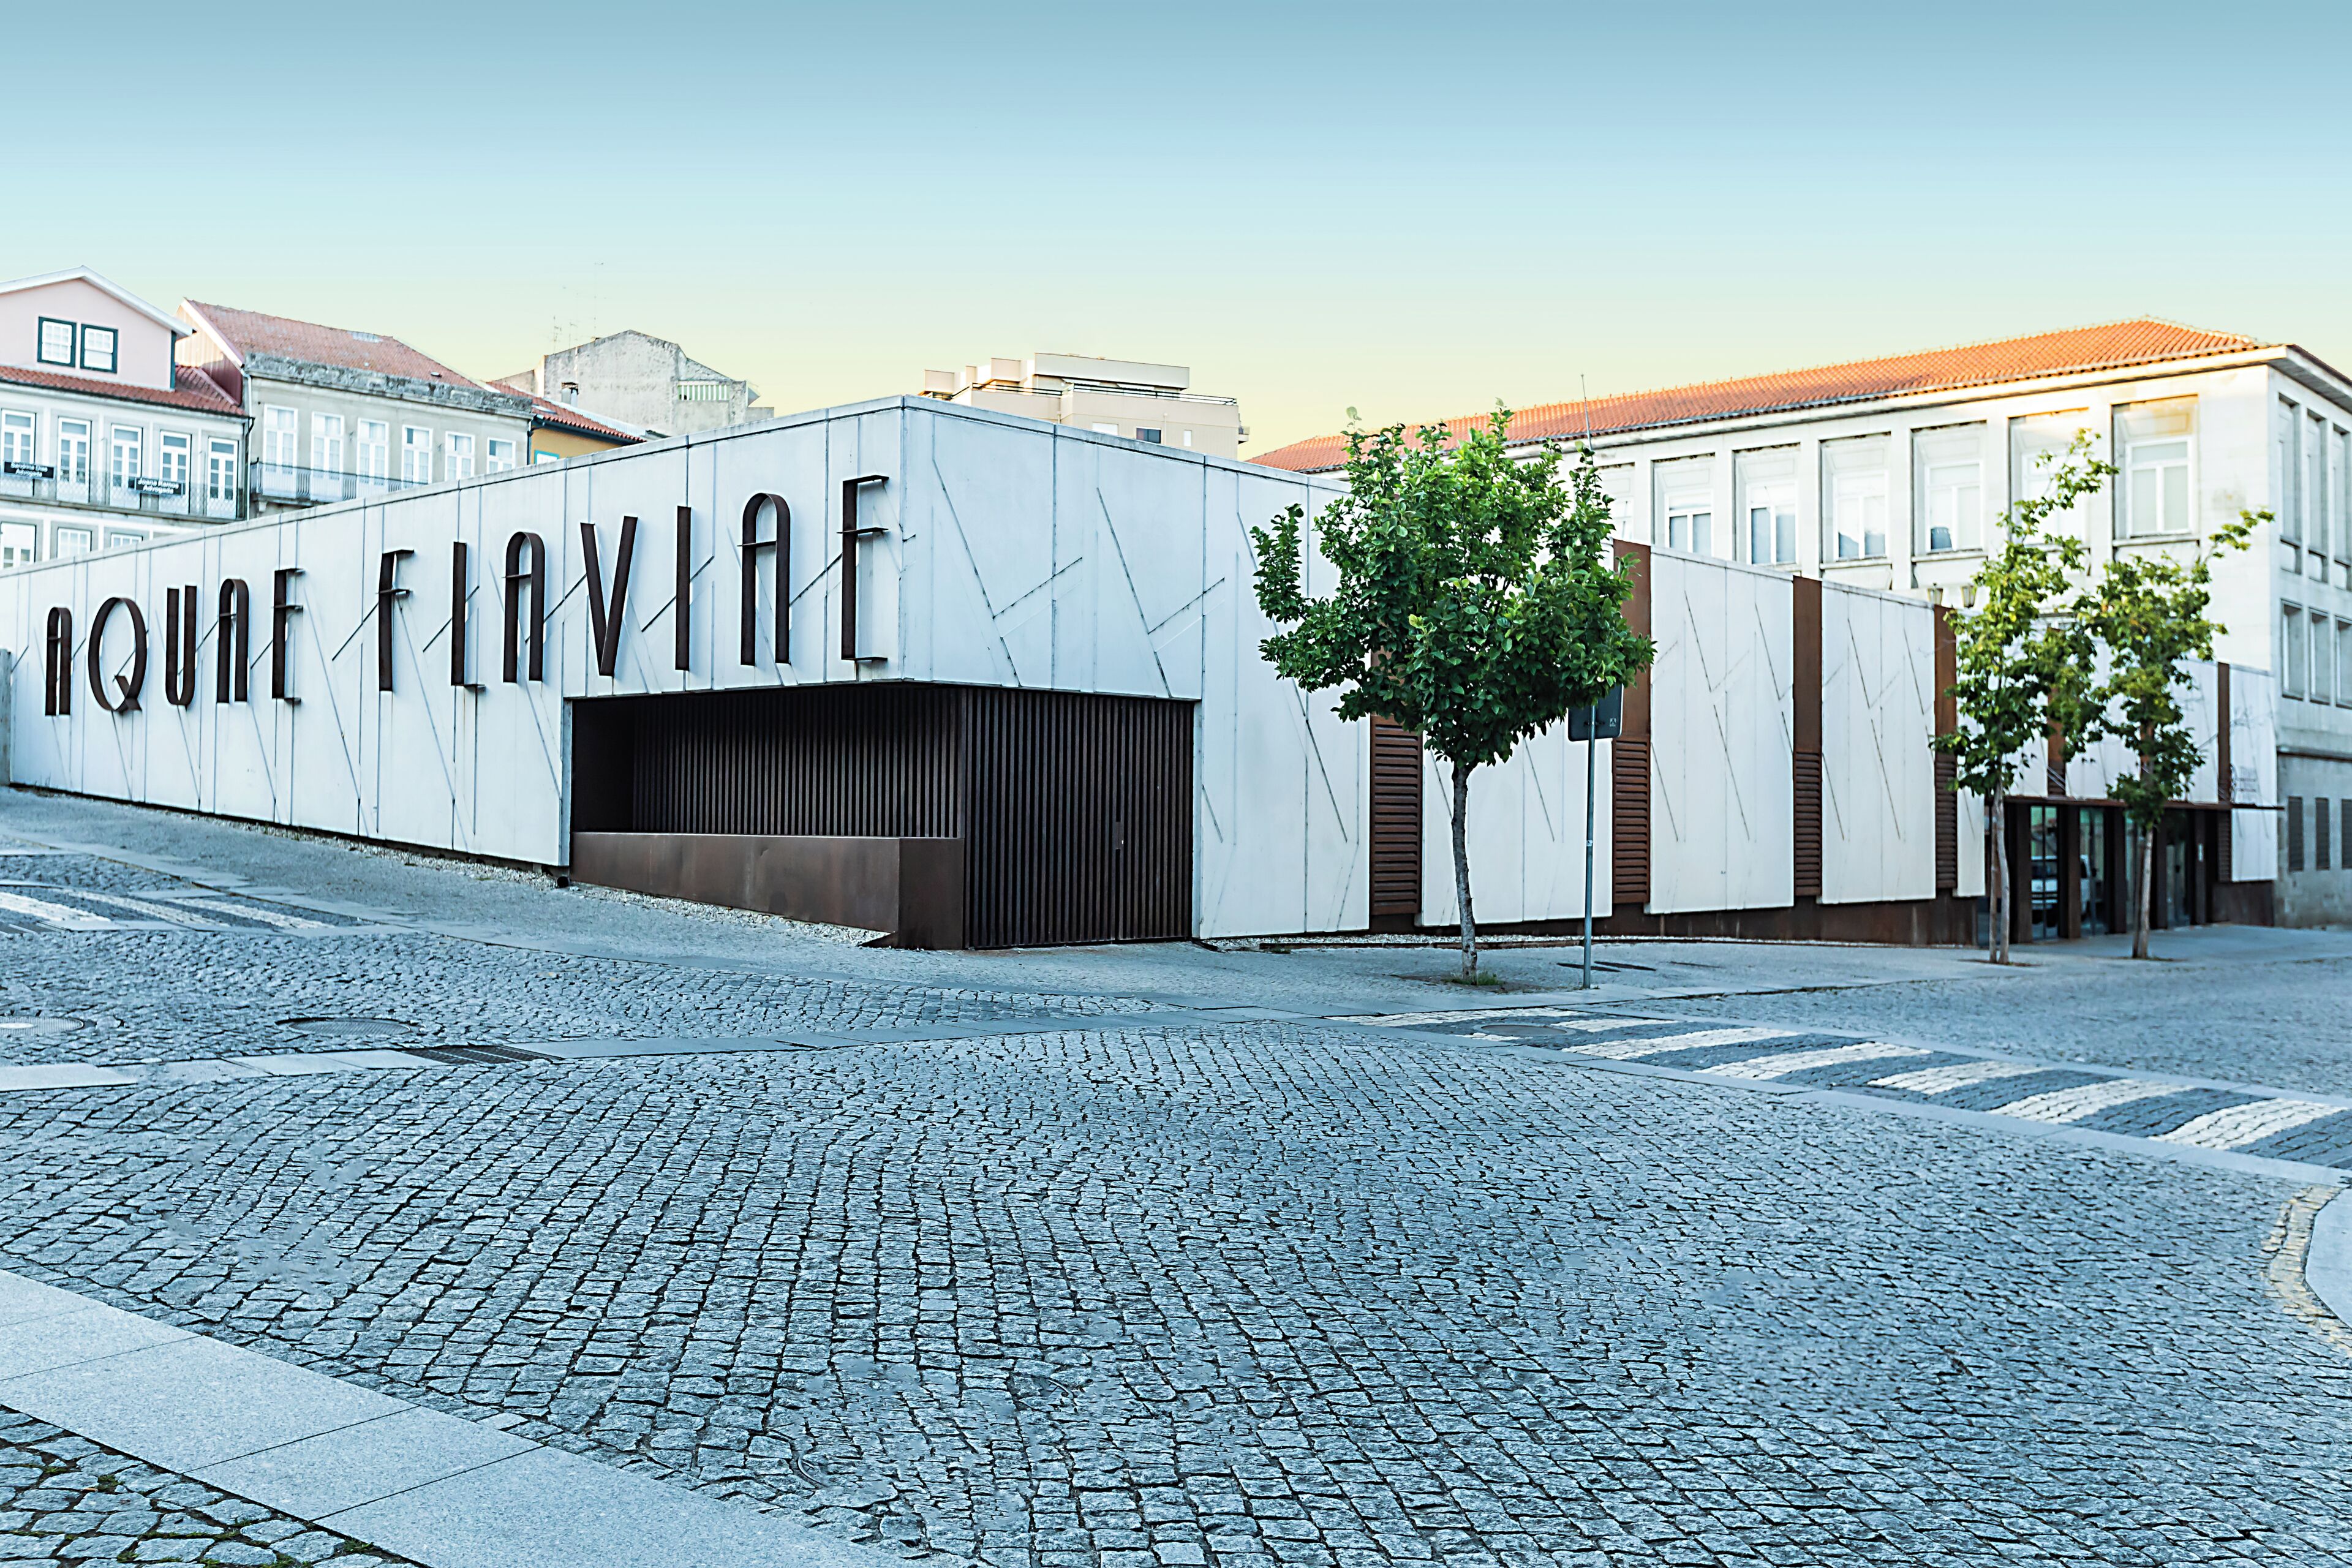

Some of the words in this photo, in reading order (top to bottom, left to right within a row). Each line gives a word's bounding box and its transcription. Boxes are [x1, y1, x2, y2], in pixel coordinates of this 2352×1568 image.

[15, 468, 42, 477] Advogada
[138, 478, 157, 486] Joana
[158, 480, 179, 489] Ramos
[143, 484, 174, 494] Advogada
[45, 568, 305, 716] AQUAE
[376, 475, 889, 691] FLAVIAE
